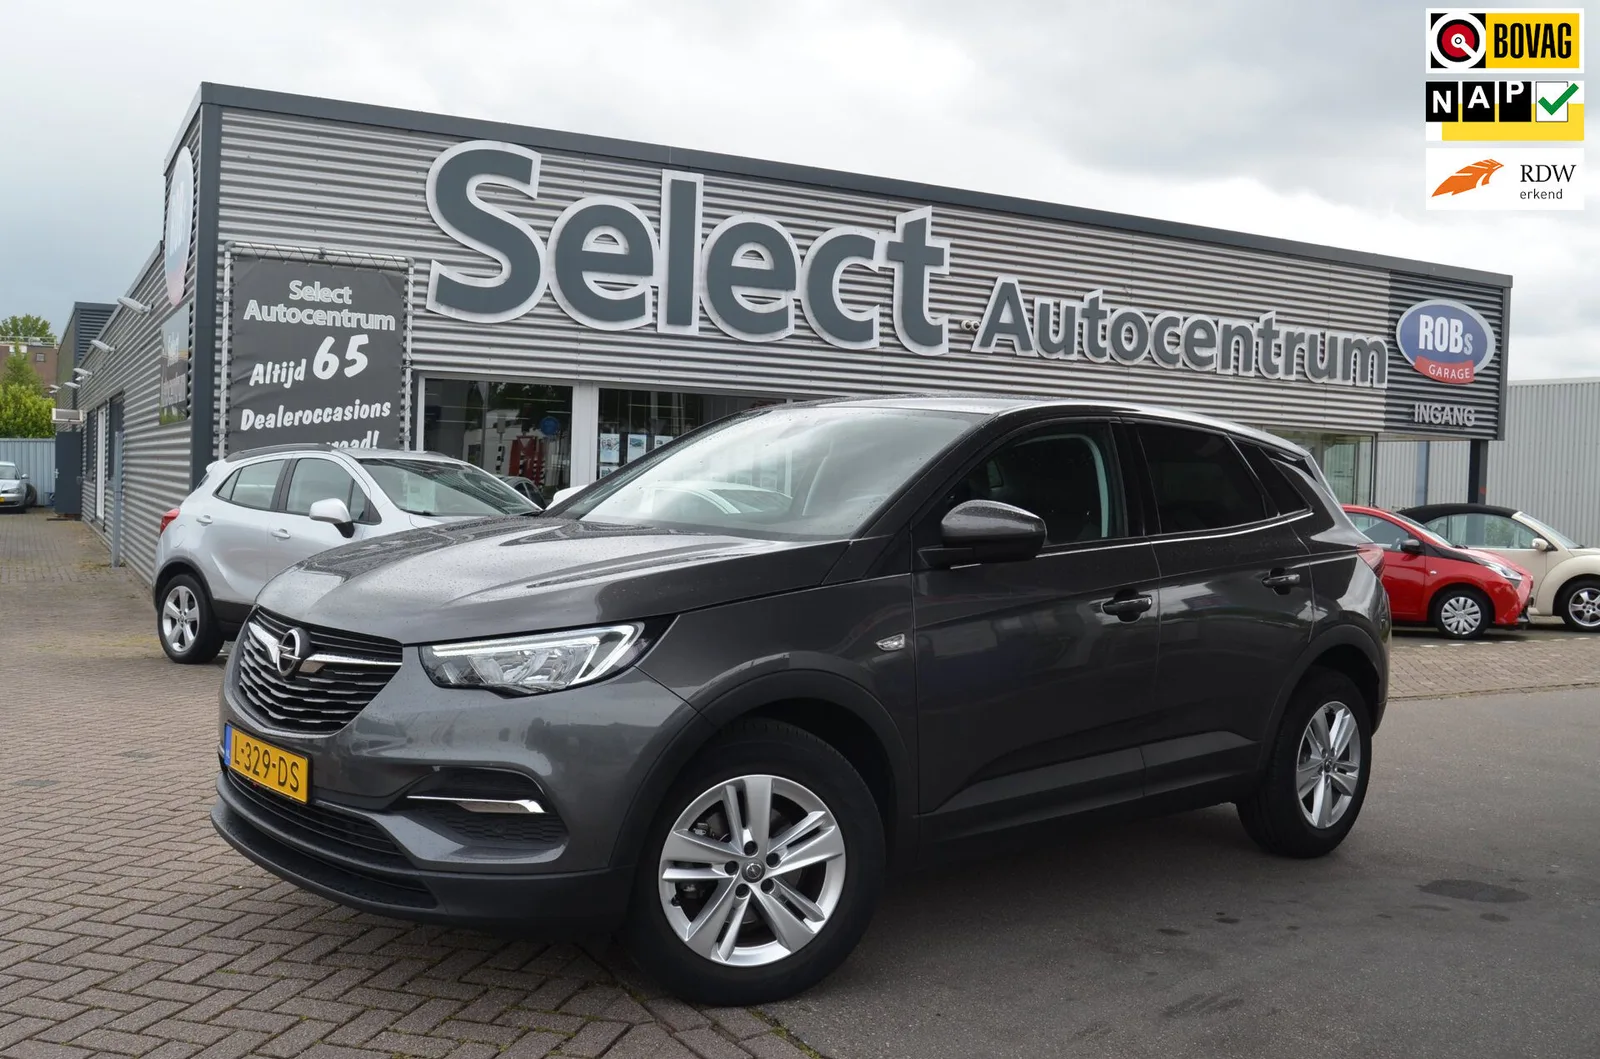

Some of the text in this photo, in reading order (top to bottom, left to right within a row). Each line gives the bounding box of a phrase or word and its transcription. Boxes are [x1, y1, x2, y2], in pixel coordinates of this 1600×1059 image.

[425, 139, 1388, 388] Select Autocentrum
[289, 279, 352, 305] Select
[243, 299, 396, 331] Autocentrum
[1419, 313, 1473, 356] ROBs
[249, 333, 369, 389] Altijd 65
[1428, 364, 1471, 379] GARAGE
[240, 398, 391, 432] Dealeroccasions
[1414, 402, 1475, 427] INGANG
[234, 734, 300, 793] L-329-DS
